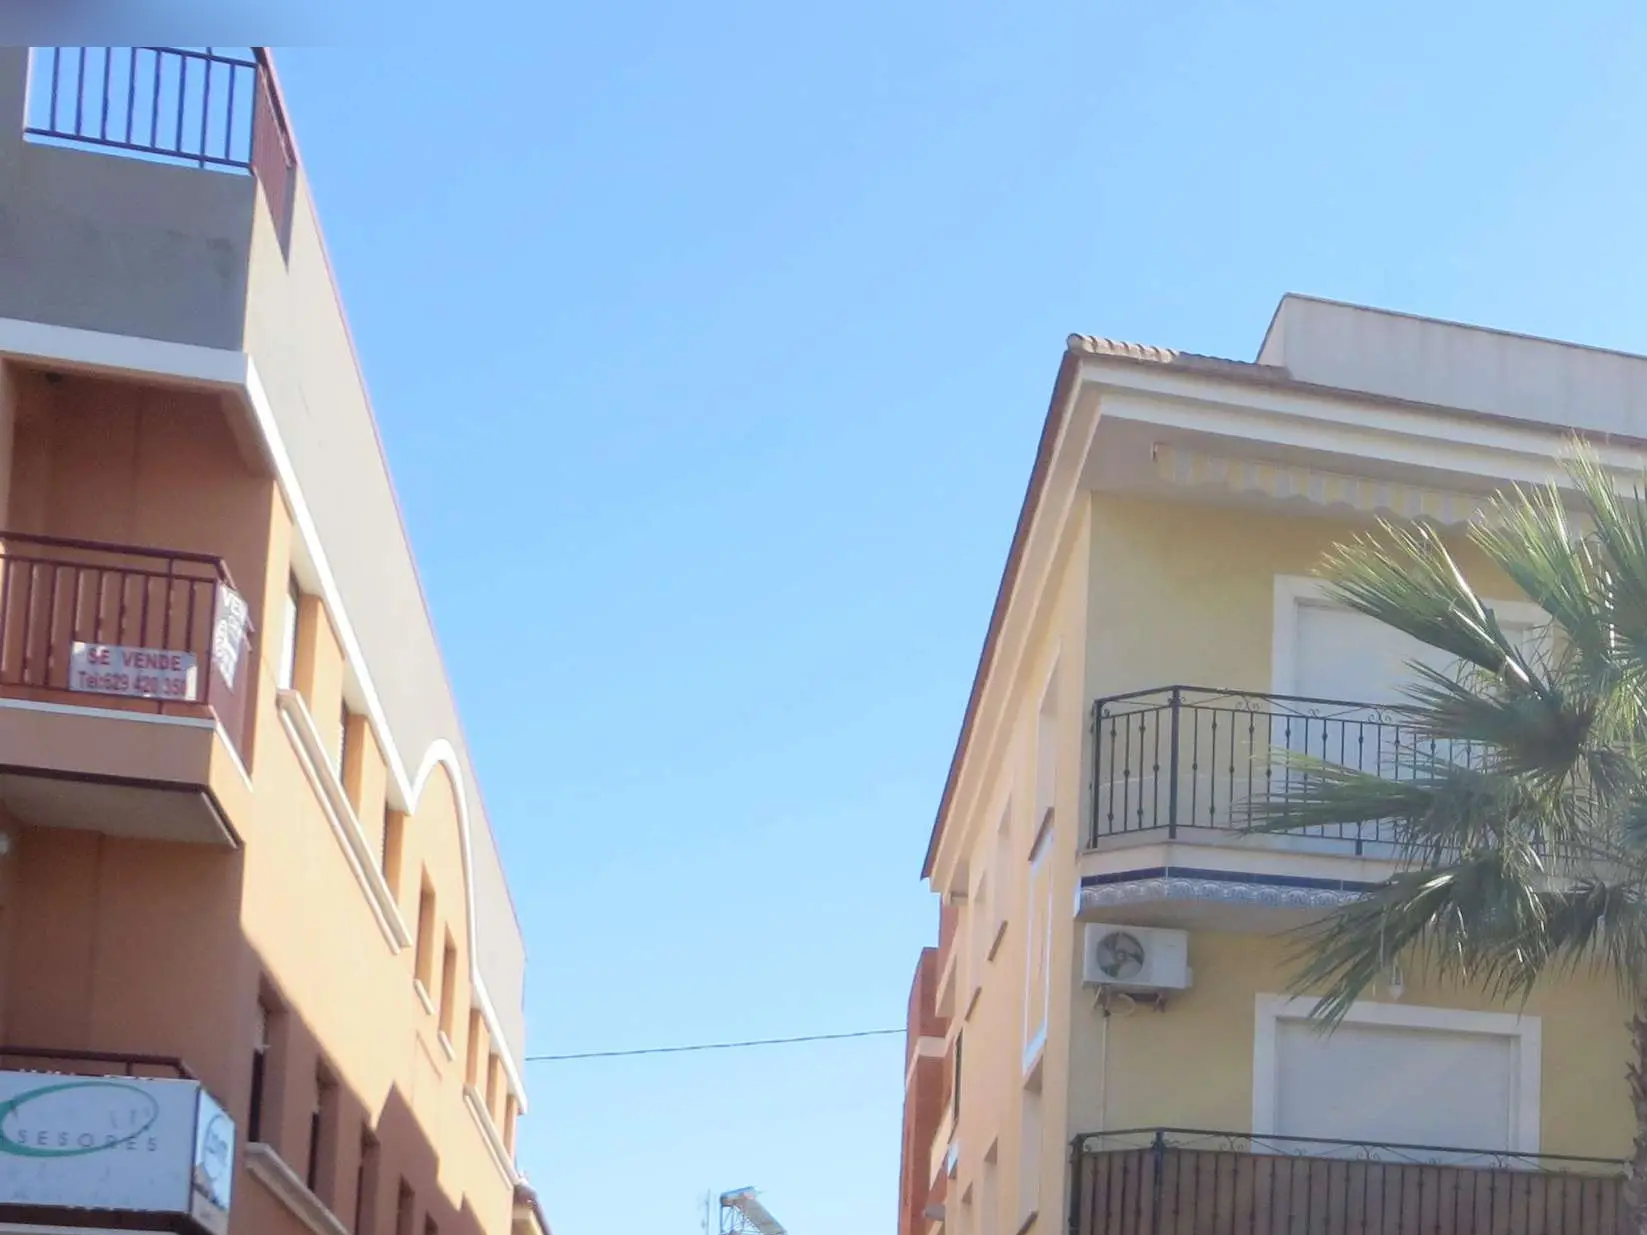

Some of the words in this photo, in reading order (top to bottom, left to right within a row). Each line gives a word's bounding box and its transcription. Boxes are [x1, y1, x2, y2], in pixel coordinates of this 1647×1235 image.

[88, 647, 110, 666] SE
[122, 650, 181, 672] VENDE
[0, 1128, 157, 1151] SESORES
